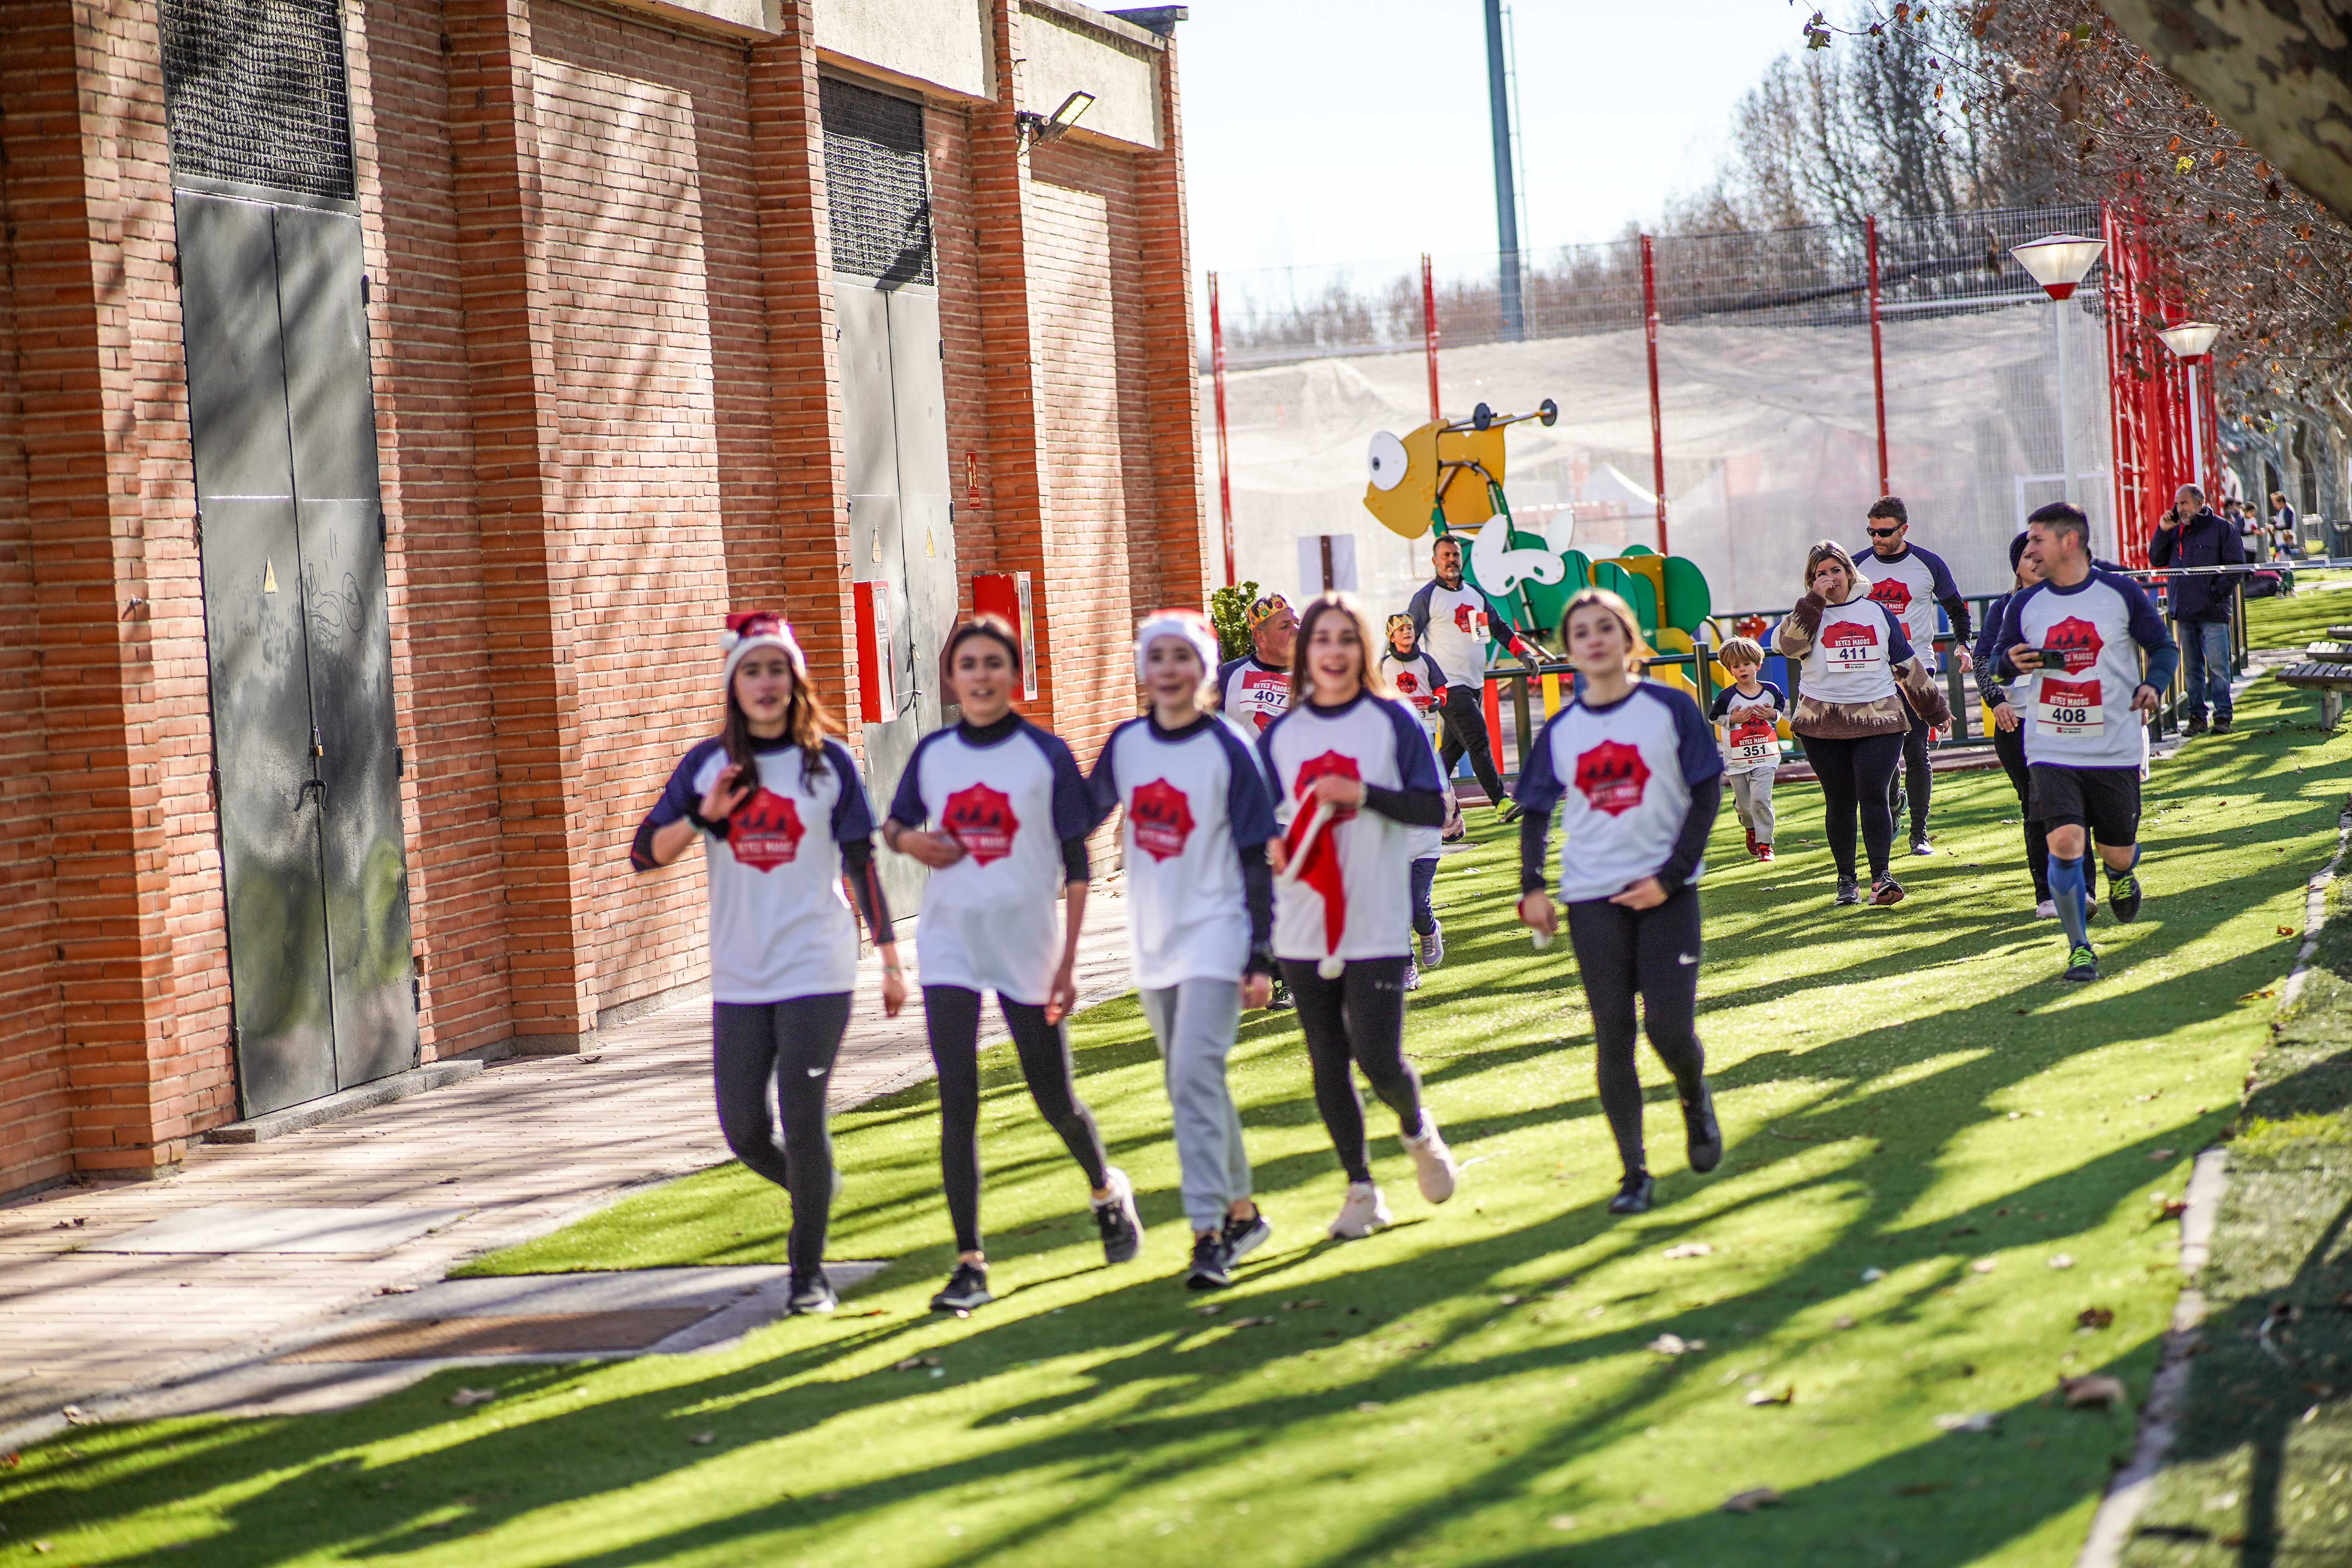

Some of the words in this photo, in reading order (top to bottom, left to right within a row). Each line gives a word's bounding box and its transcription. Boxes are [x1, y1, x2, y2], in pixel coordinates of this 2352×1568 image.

[1839, 647, 1866, 659] 411
[1271, 684, 1291, 693] MAGOS
[1254, 690, 1286, 705] 407
[2049, 695, 2066, 705] REYES
[2067, 697, 2090, 706] MAGOS
[2052, 708, 2085, 723] 408
[1743, 744, 1766, 757] 351
